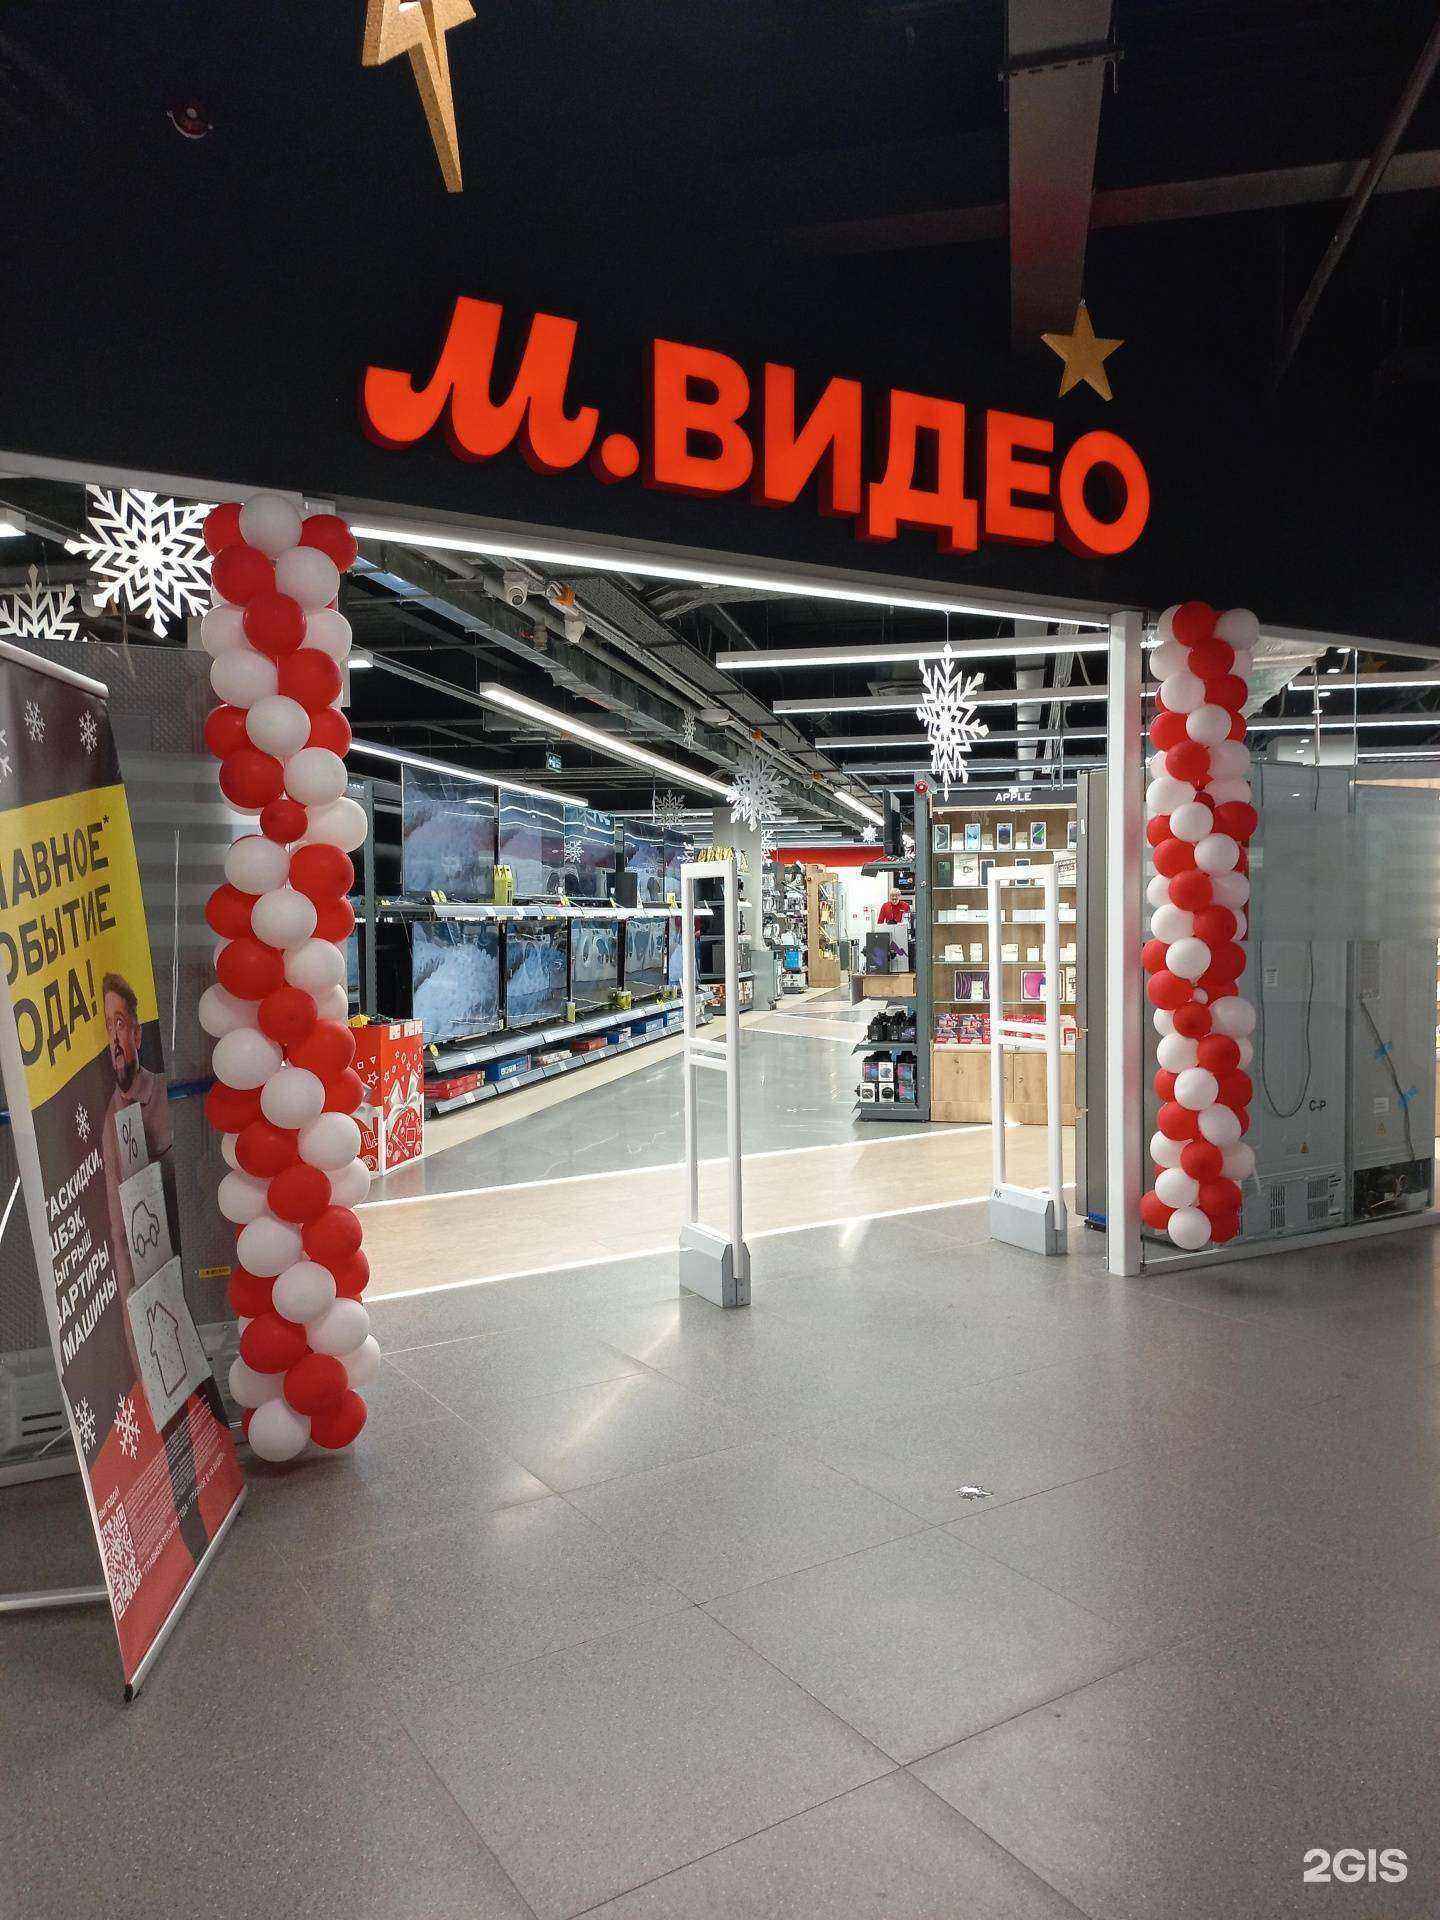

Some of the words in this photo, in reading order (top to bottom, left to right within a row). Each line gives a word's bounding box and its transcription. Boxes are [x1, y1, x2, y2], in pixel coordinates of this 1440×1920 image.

[364, 297, 1150, 554] М.ВИДЕО
[995, 792, 1032, 802] APPLE
[13, 959, 98, 1066] ОДА!
[62, 1269, 118, 1367] МАШИНЫ
